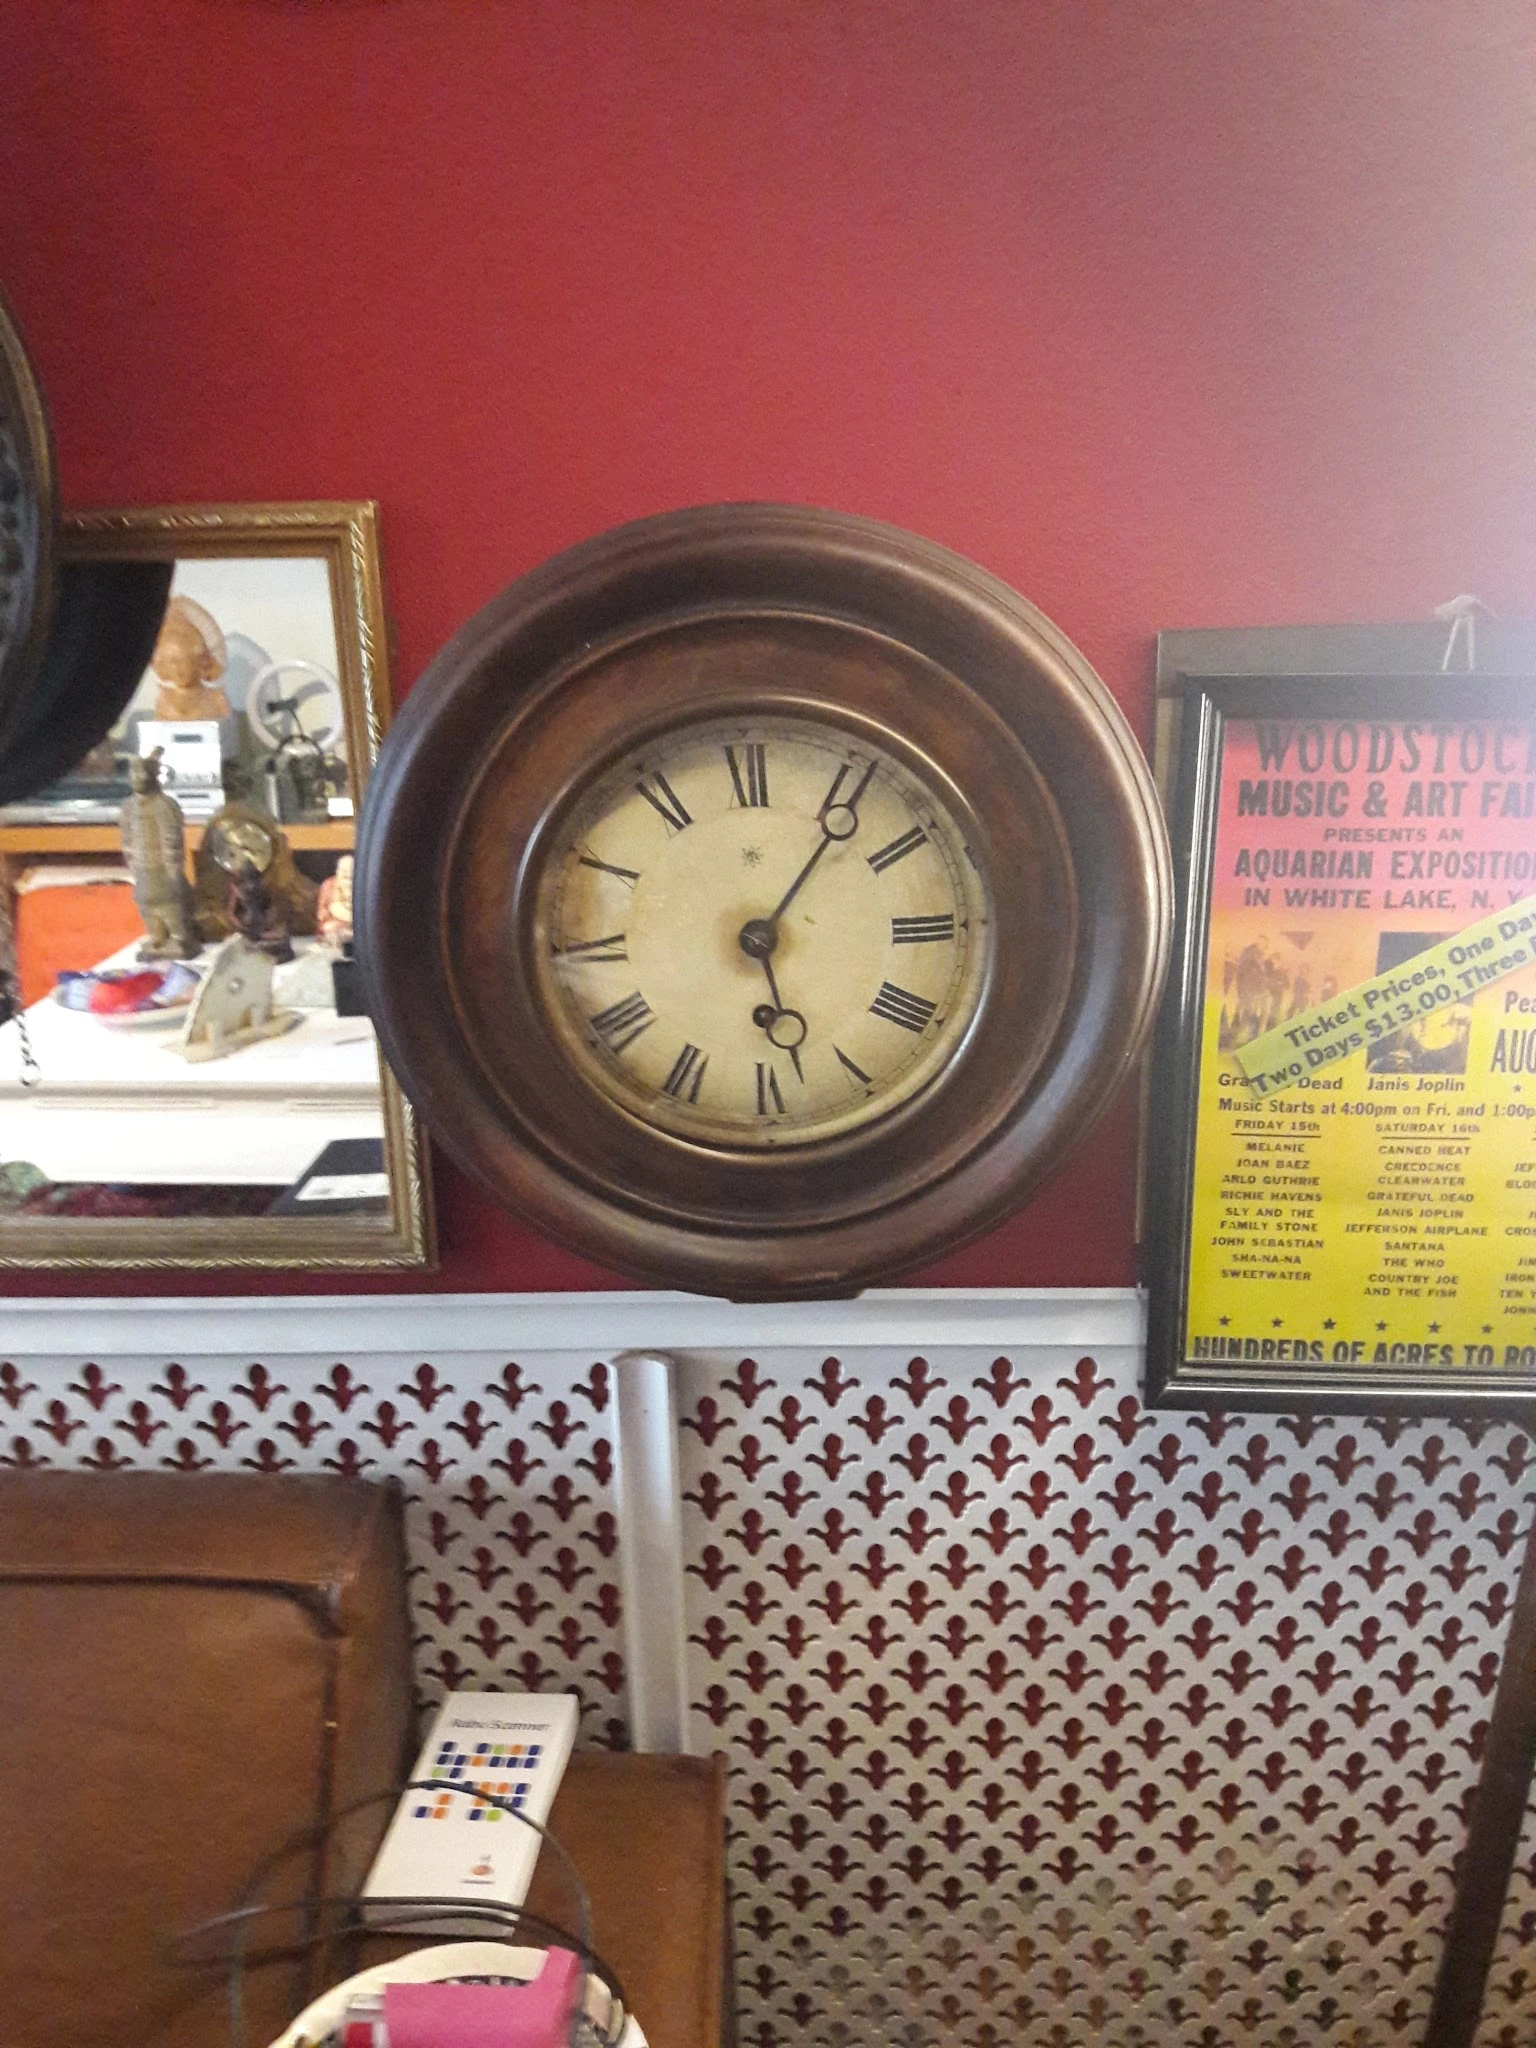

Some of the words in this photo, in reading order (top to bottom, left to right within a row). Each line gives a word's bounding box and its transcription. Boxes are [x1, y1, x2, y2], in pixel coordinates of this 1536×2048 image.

[1237, 780, 1349, 817] MUSIC
[1362, 781, 1386, 818] &
[1403, 781, 1468, 818] ART
[1324, 828, 1427, 843] PRESENTS
[1438, 829, 1464, 843] AN
[1234, 848, 1374, 882] AQUARIAN
[1390, 851, 1536, 880] EXPOSITIO
[1244, 888, 1271, 907] IN
[1284, 889, 1370, 908] WHITE
[1384, 890, 1457, 912] LAKE,
[1472, 890, 1495, 909] N.
[1284, 1002, 1361, 1047] Ticket
[1363, 964, 1446, 1010] Prices,
[1448, 937, 1495, 965] One
[1251, 1063, 1303, 1093] Two
[1304, 1032, 1364, 1068] Days
[1364, 984, 1461, 1039] $13.00,
[1457, 949, 1527, 990] Three
[1297, 1076, 1343, 1090] Dead
[1367, 1078, 1409, 1092] Janis
[1416, 1078, 1465, 1094] Joplin
[1219, 1098, 1262, 1112] Music
[1269, 1100, 1315, 1114] Starts
[1321, 1103, 1336, 1114] at
[1340, 1102, 1397, 1117] 4:00pm
[1403, 1106, 1420, 1116] on
[1426, 1104, 1451, 1116] Fri.
[1457, 1104, 1485, 1117] and
[1234, 1119, 1284, 1130] FRIDAY
[1290, 1121, 1321, 1132] 15th
[1375, 1123, 1444, 1133] SATURDAY
[1453, 1124, 1481, 1133] 16th
[1245, 1142, 1305, 1152] MELANIE
[1378, 1146, 1431, 1155] CANNED
[1438, 1146, 1471, 1155] HEAT
[1237, 1158, 1269, 1168] JOAN
[1276, 1160, 1310, 1169] BAEZ
[1221, 1174, 1256, 1184] ARLO
[1262, 1176, 1320, 1186] GUTHRIE
[1378, 1176, 1466, 1186] CLEARWATER
[1220, 1190, 1264, 1200] RICHIE
[1270, 1192, 1322, 1202] HAVENS
[1367, 1191, 1434, 1202] GRATEFUL
[1440, 1193, 1475, 1202] DEAD
[1225, 1207, 1250, 1216] SLY
[1256, 1208, 1283, 1217] AND
[1291, 1209, 1315, 1218] THE
[1377, 1207, 1414, 1217] JANIS
[1419, 1208, 1464, 1219] JOPLIN
[1220, 1220, 1269, 1231] FAMILY
[1276, 1222, 1319, 1232] STONE
[1345, 1223, 1418, 1234] JEFFERSON
[1424, 1225, 1489, 1236] AIRPLANE
[1211, 1236, 1245, 1246] JOHN
[1252, 1238, 1324, 1248] SEBASTIAN
[1385, 1241, 1445, 1251] SANTANA
[1232, 1253, 1302, 1264] SHA-NA-NA
[1383, 1258, 1408, 1267] THE
[1415, 1259, 1445, 1268] WHO
[1221, 1269, 1312, 1280] SWEETWATER
[1368, 1273, 1430, 1284] COUNTRY
[1436, 1275, 1459, 1284] JOE
[1364, 1287, 1391, 1297] AND
[1398, 1288, 1421, 1297] THE
[1427, 1289, 1457, 1298] FISH
[1193, 1335, 1325, 1362] HUNDREDS
[1332, 1340, 1366, 1364] OF
[1372, 1342, 1453, 1366] ACRES
[1464, 1344, 1495, 1366] TO
